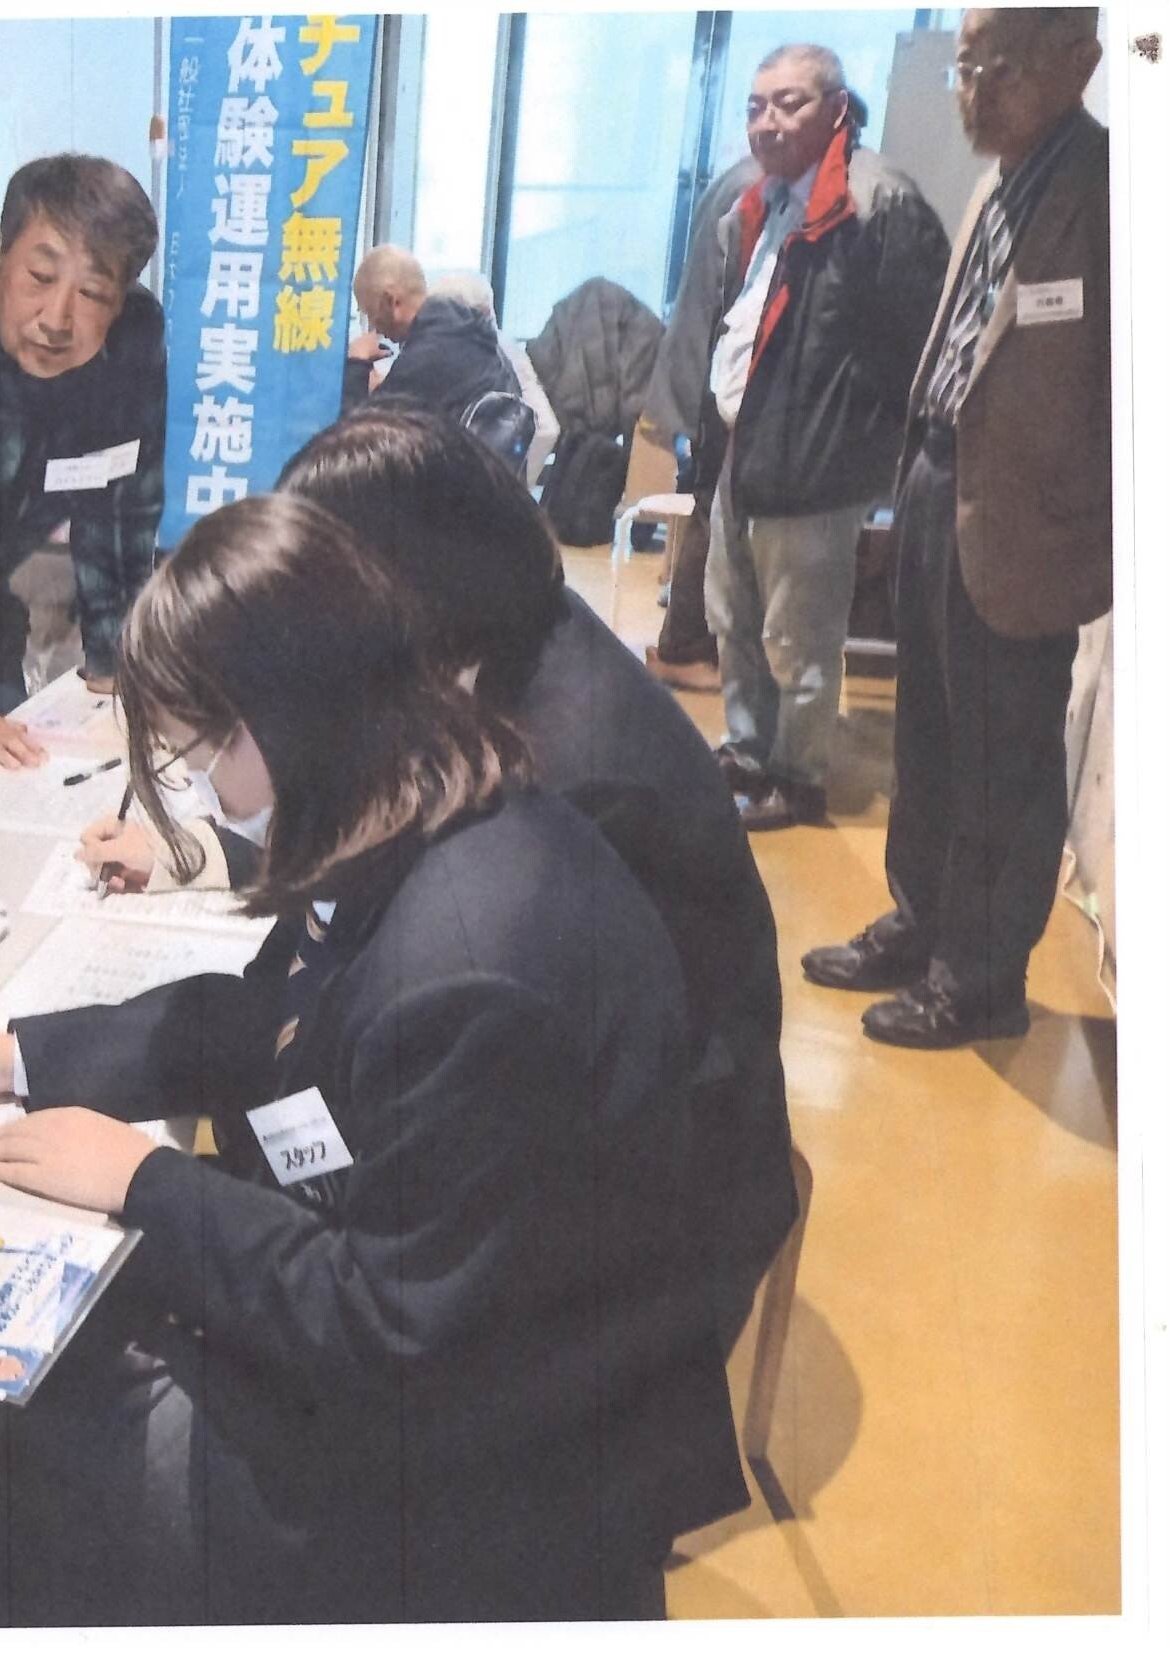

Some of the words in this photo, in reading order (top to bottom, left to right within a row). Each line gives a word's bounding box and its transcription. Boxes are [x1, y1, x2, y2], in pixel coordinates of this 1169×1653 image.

[185, 15, 287, 515] 体験運用実施中
[272, 14, 361, 354] チュア無線
